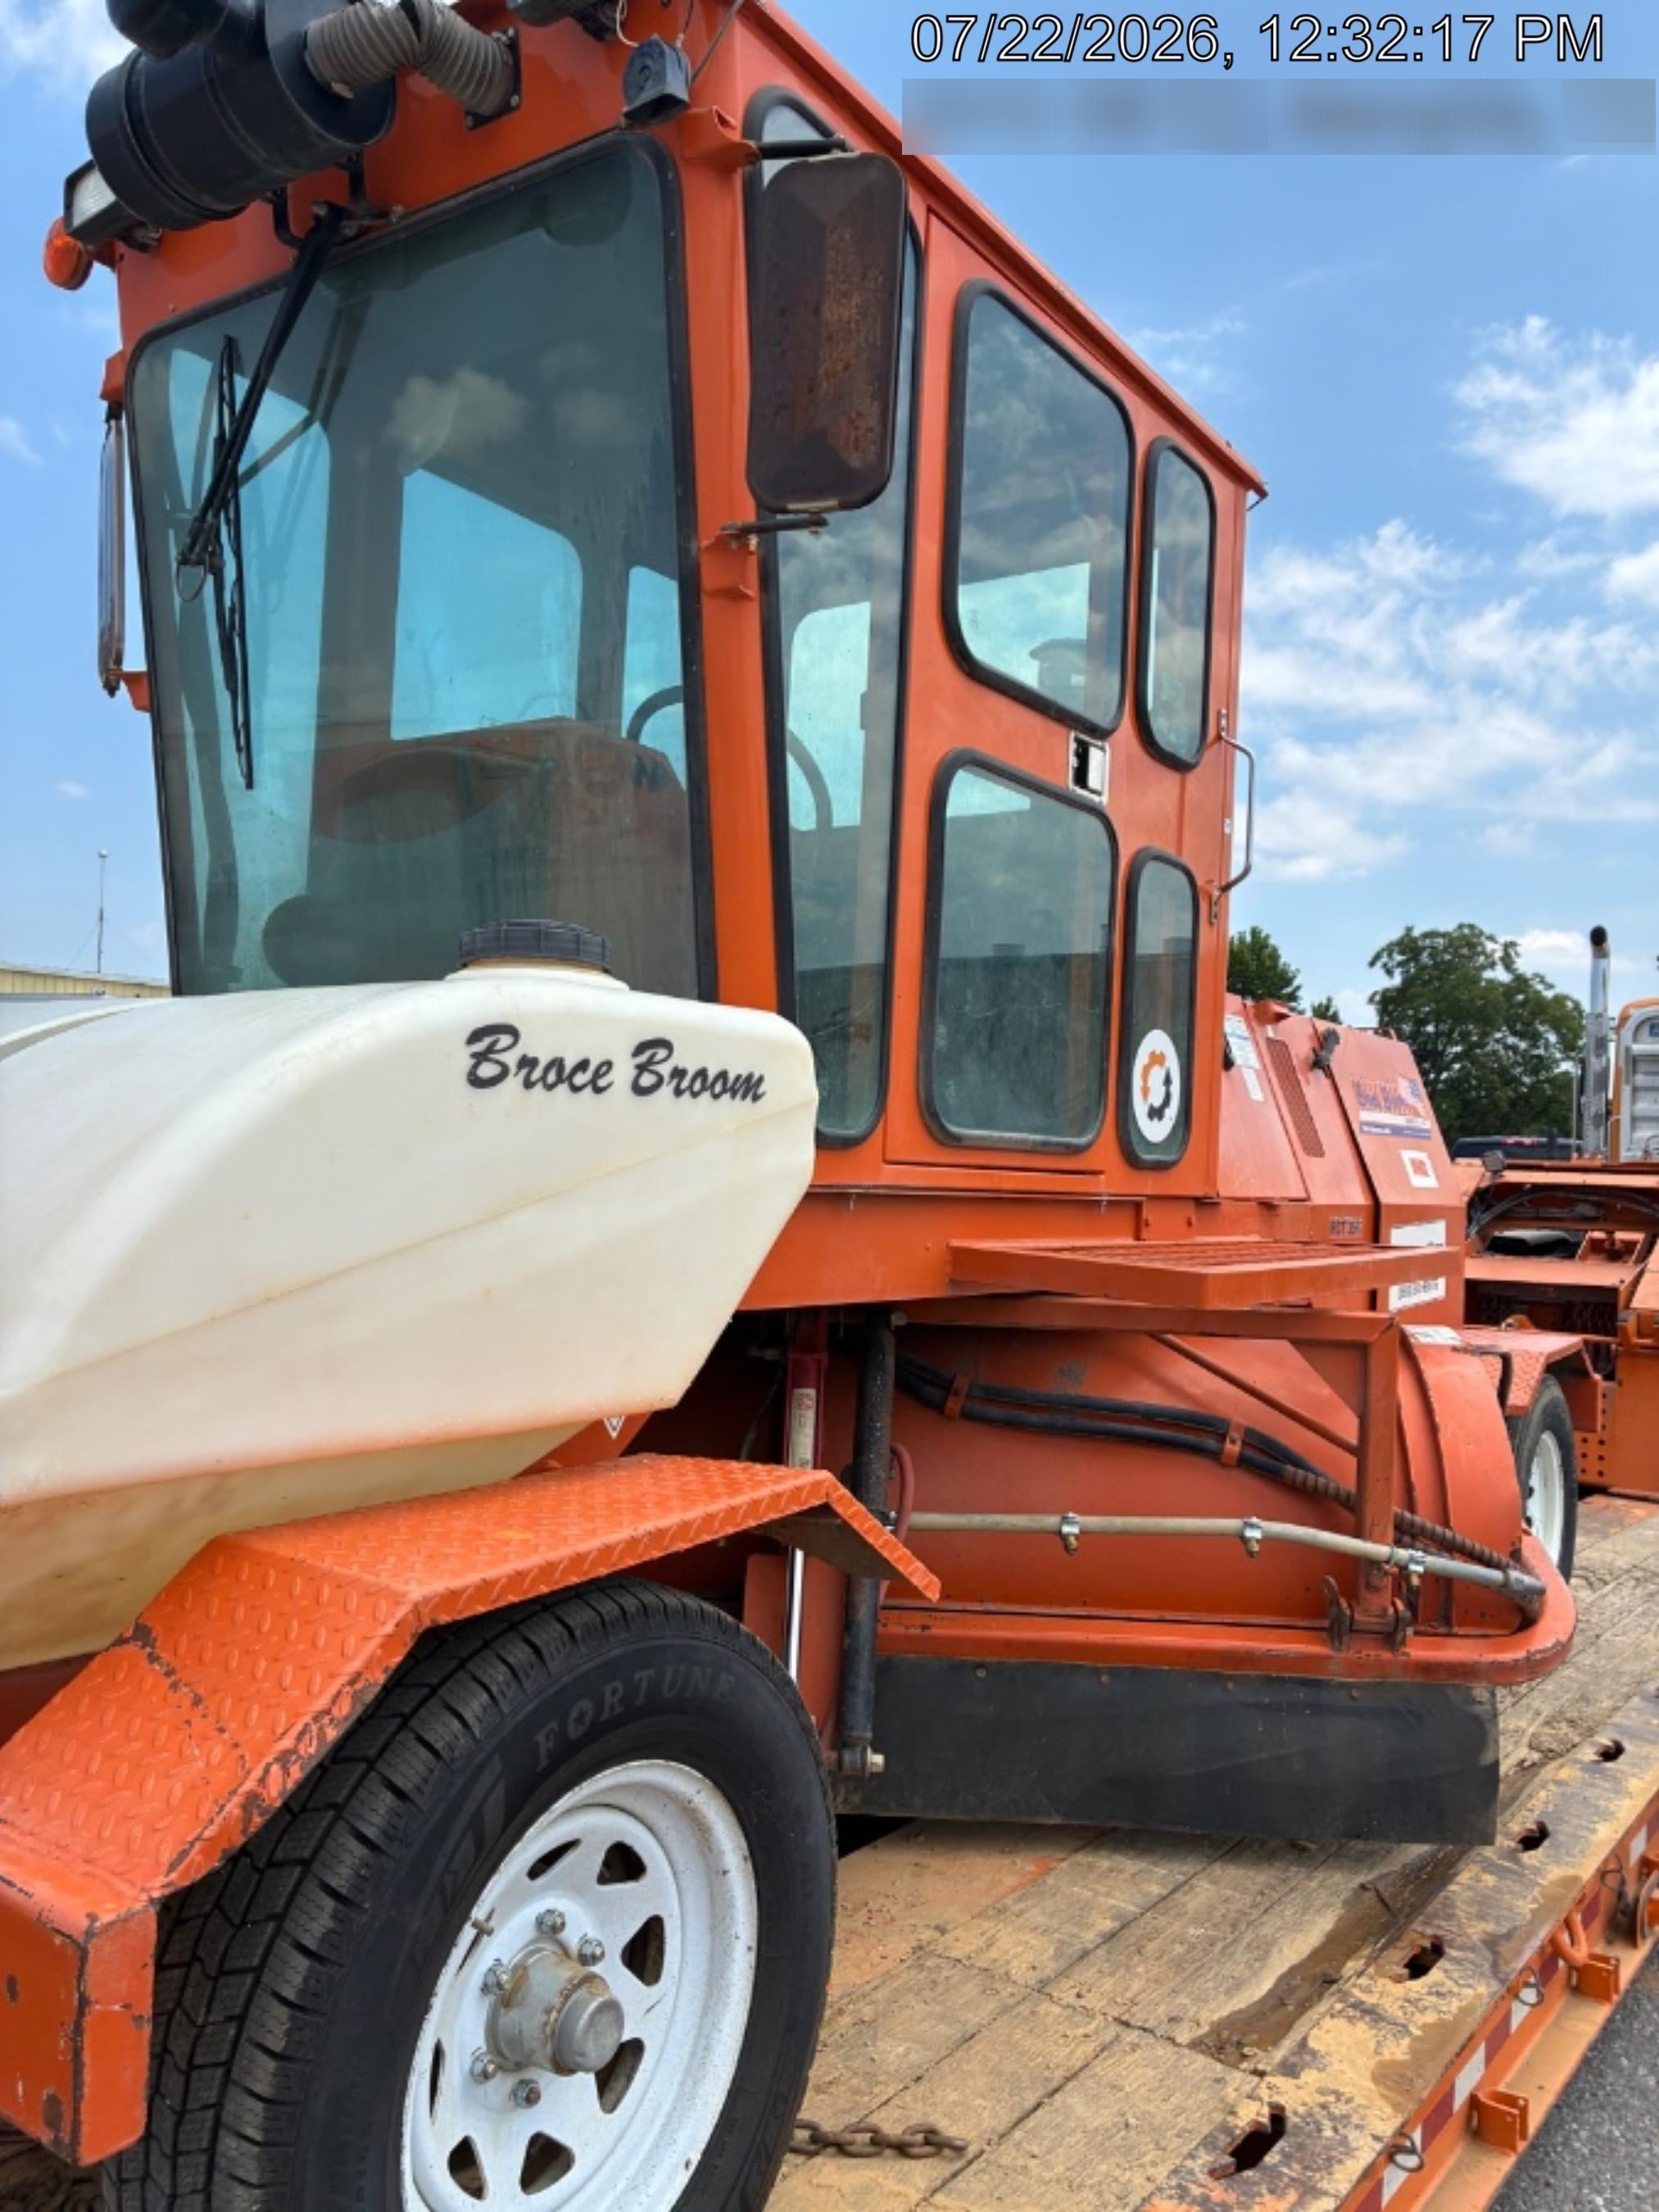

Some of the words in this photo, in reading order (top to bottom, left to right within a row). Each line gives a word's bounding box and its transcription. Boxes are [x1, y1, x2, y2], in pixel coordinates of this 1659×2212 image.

[465, 1022, 614, 1095] Broce
[631, 1036, 767, 1104] Broom
[533, 1665, 736, 1773] FORTUNE
